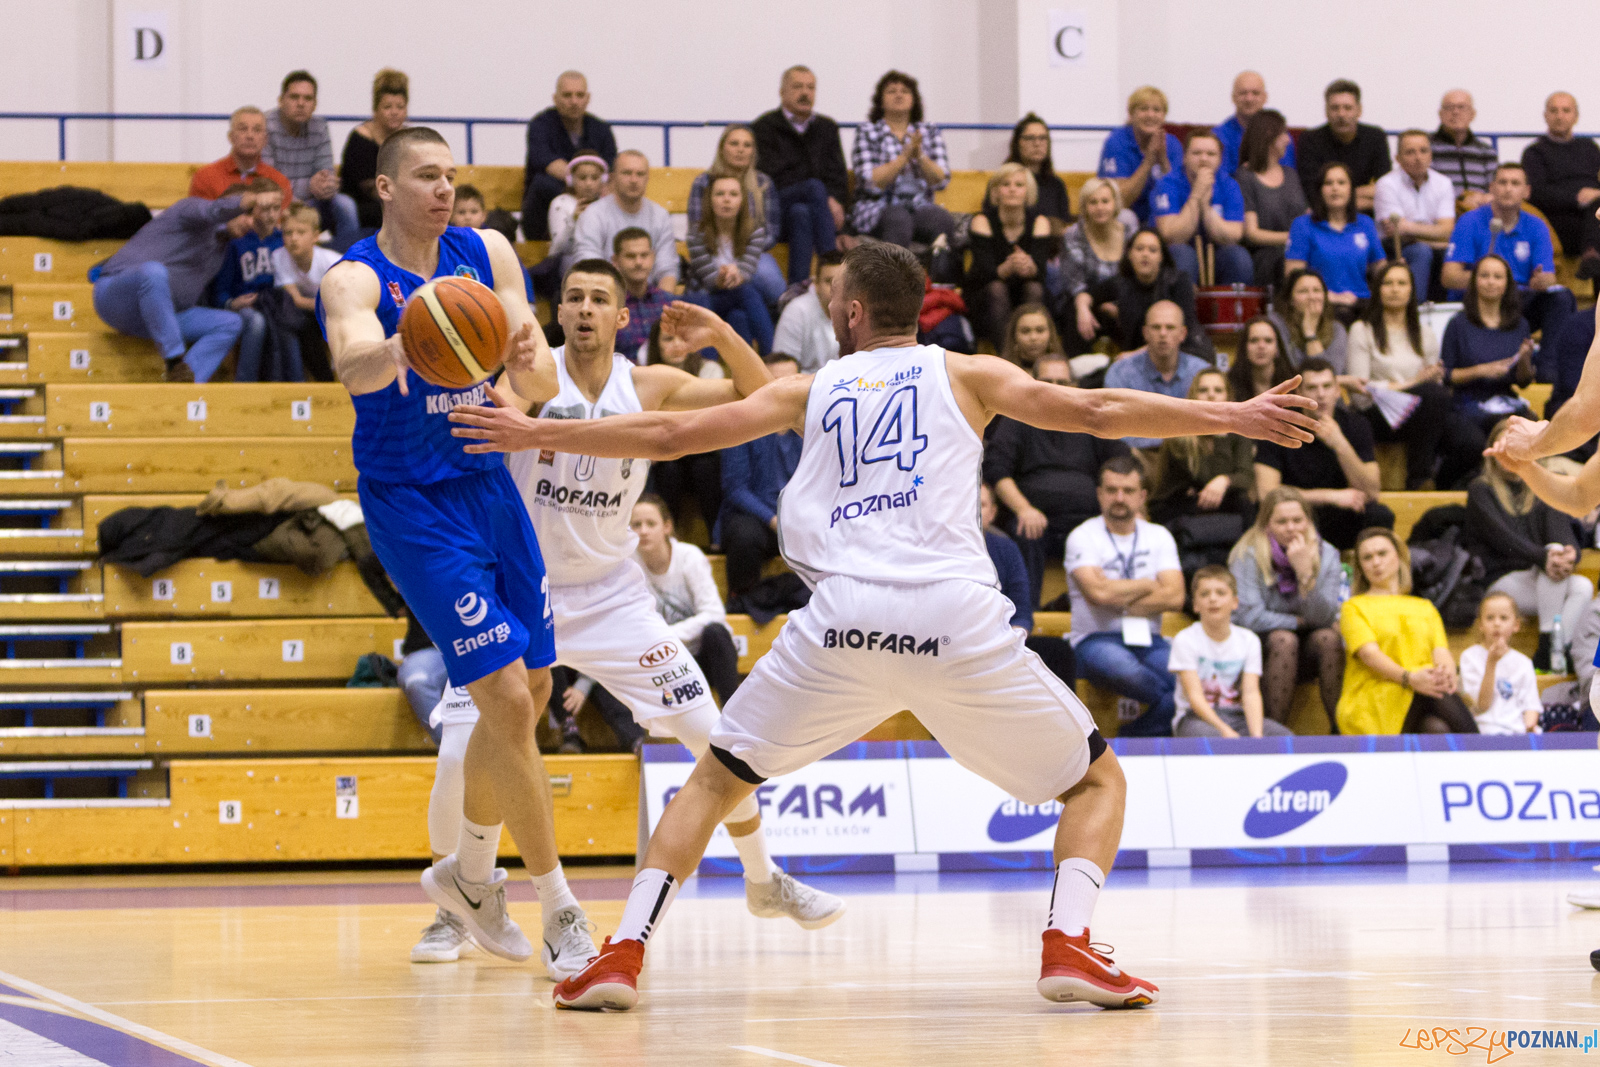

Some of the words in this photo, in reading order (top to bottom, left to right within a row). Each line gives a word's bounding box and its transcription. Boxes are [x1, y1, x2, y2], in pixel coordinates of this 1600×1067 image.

[134, 28, 164, 61] D
[1054, 26, 1083, 60] C
[241, 246, 274, 282] GA
[822, 384, 928, 488] 14
[288, 643, 297, 658] 7
[453, 622, 511, 657] Energa
[177, 646, 186, 661] 8
[645, 645, 675, 665] KIA
[651, 662, 693, 687] DELIK
[672, 680, 704, 705] PBG
[195, 718, 204, 733] 8
[342, 799, 352, 814] 7
[1256, 785, 1332, 812] atrem
[226, 804, 235, 819] 8
[765, 826, 818, 837] DUCENT
